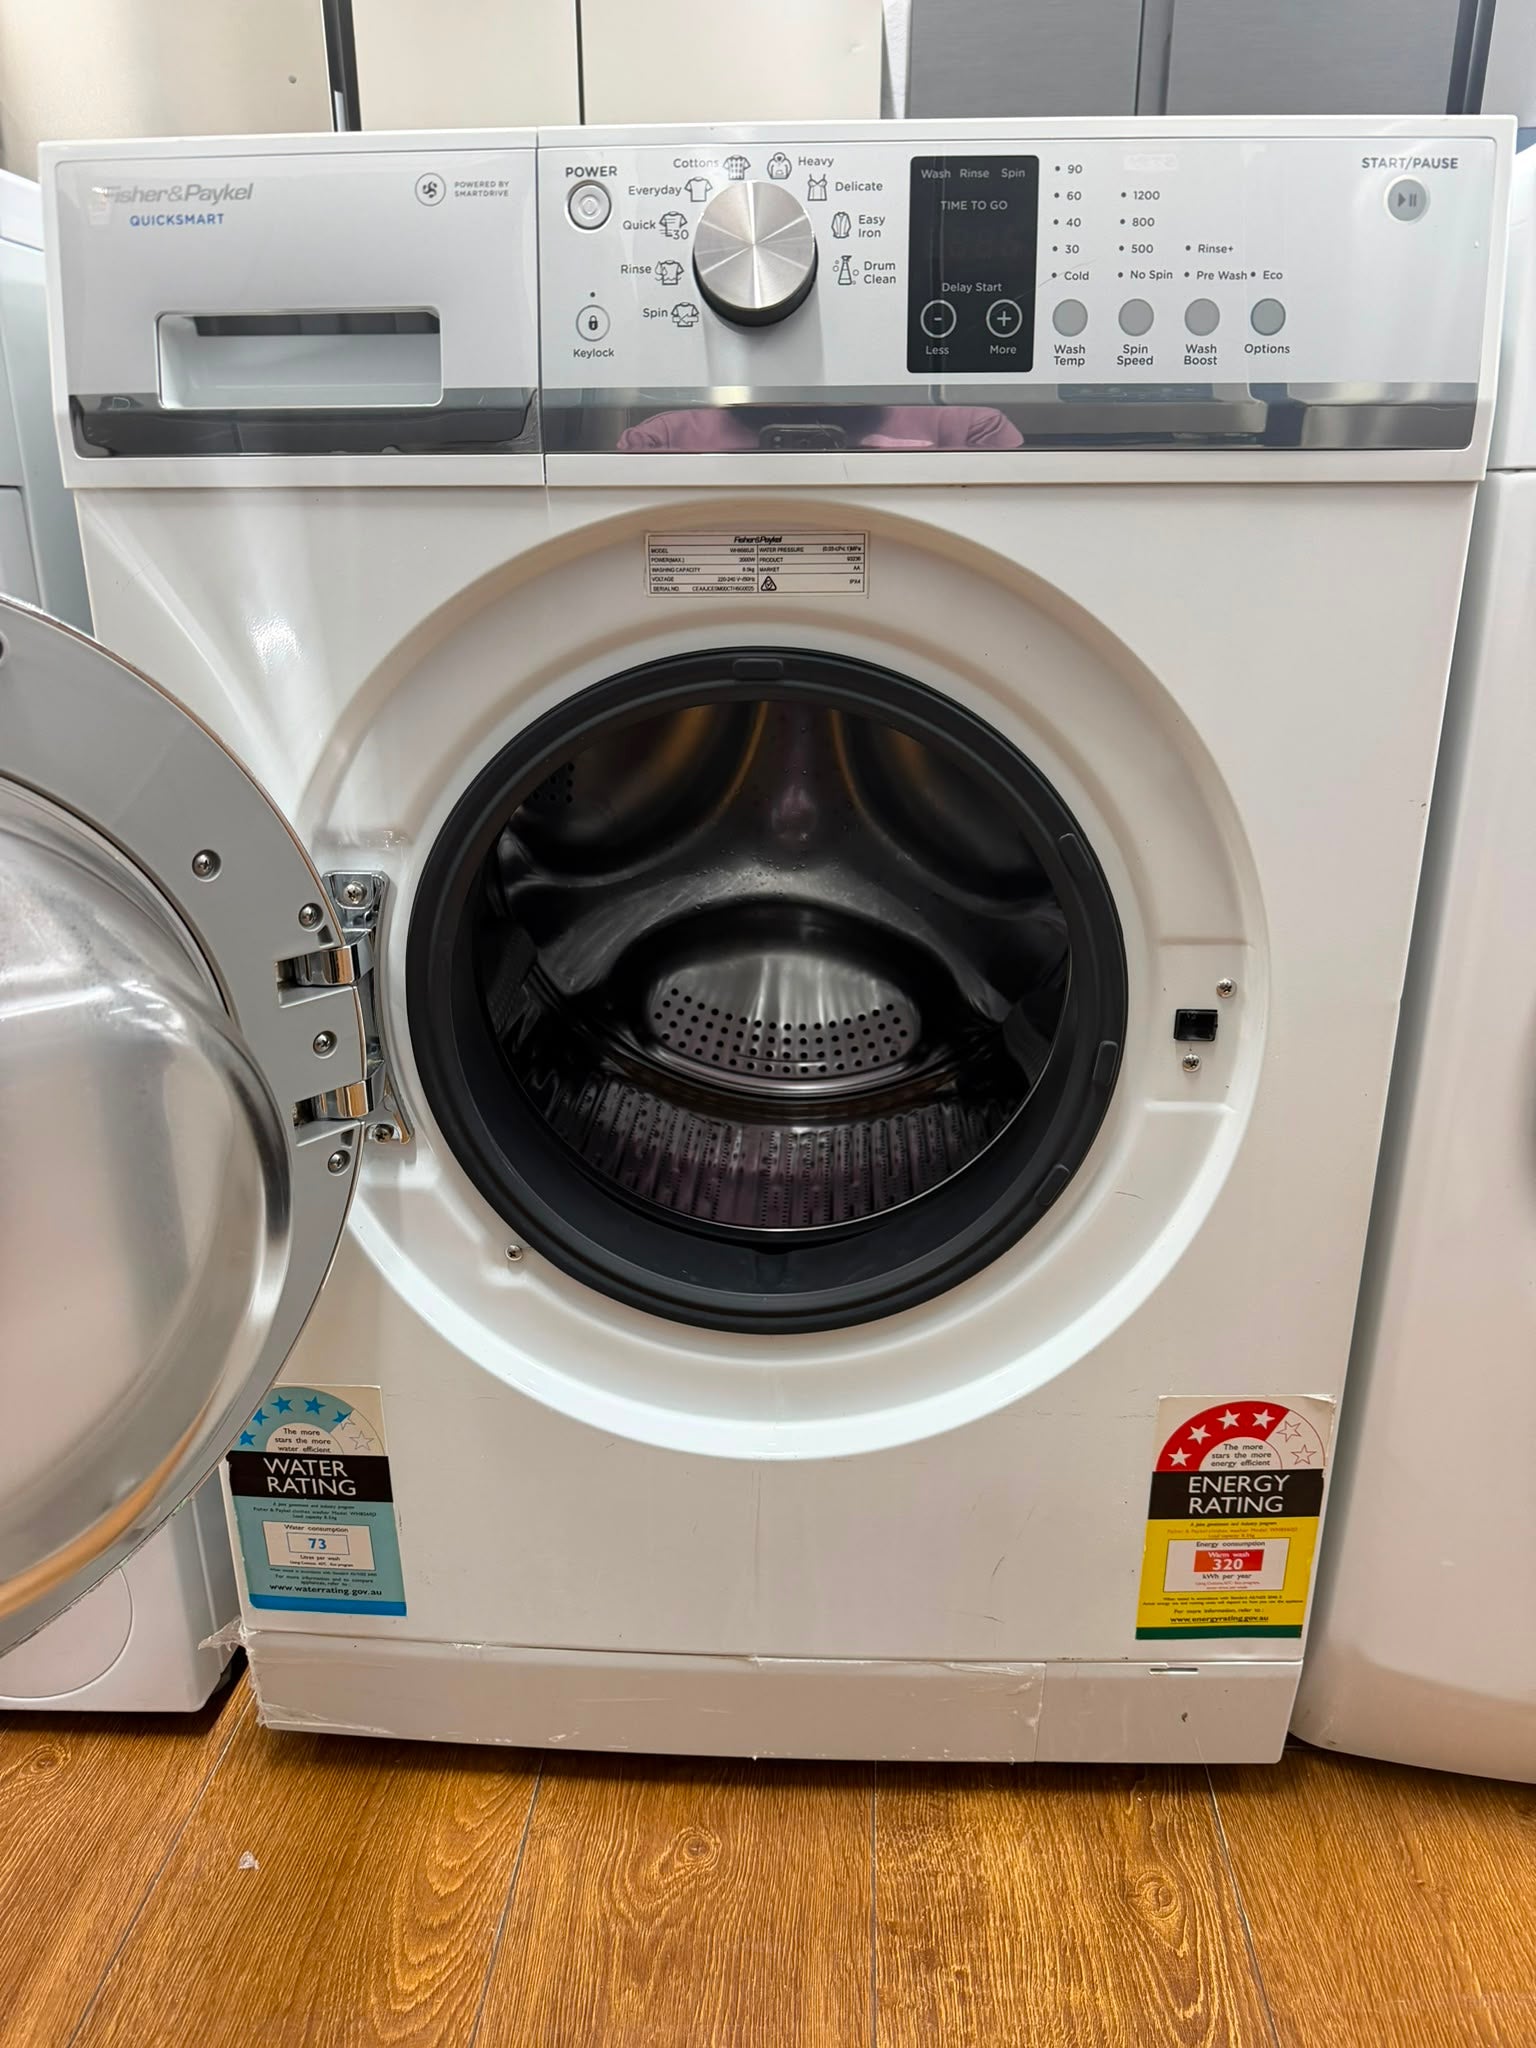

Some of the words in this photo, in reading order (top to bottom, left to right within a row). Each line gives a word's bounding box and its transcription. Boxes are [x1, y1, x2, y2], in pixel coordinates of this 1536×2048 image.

[673, 157, 720, 169] Cottons
[798, 156, 834, 168] Heavy
[1361, 157, 1459, 170] START/PAUSE
[565, 165, 618, 178] POWER
[921, 167, 952, 179] Wash
[960, 167, 990, 179] Rinse
[1001, 167, 1026, 180] Spin
[1067, 164, 1083, 175] 90
[498, 180, 509, 188] BY
[835, 181, 883, 192] Delicate
[628, 185, 682, 197] Everyday
[1067, 191, 1082, 201] 60
[1133, 190, 1160, 201] 1200
[941, 200, 968, 211] TIME
[970, 200, 988, 211] TO
[990, 200, 1008, 211] GO
[129, 213, 224, 227] QUICKSMART
[858, 215, 886, 228] Easy
[1066, 217, 1082, 228] 40
[1132, 217, 1155, 228] 800
[623, 220, 656, 232] Quick
[673, 230, 689, 240] 30
[858, 228, 881, 238] Iron
[1065, 244, 1080, 254] 30
[1131, 244, 1154, 254] 500
[1197, 243, 1234, 254] Rinse+
[620, 263, 652, 275] Rinse
[864, 261, 896, 271] Drum
[863, 273, 896, 284] Clean
[1064, 270, 1090, 281] Cold
[1130, 270, 1146, 281] No
[1149, 270, 1174, 282] Spin
[1196, 270, 1214, 281] Pre
[1217, 270, 1248, 281] Wash
[1263, 270, 1283, 281] Eco
[942, 282, 972, 294] Delay
[976, 281, 1003, 292] Start
[642, 307, 668, 319] Spin
[573, 348, 615, 360] Keylock
[925, 345, 949, 355] Less
[989, 345, 1017, 355] More
[1054, 344, 1086, 355] Wash
[1122, 344, 1149, 357] Spin
[1185, 344, 1217, 355] Wash
[1244, 343, 1290, 357] Options
[1054, 356, 1086, 368] Temp
[1116, 355, 1154, 368] Speed
[1184, 355, 1218, 366] Boost
[283, 1428, 297, 1436] The
[302, 1445, 331, 1453] efficient
[1234, 1451, 1248, 1459] the
[263, 1457, 348, 1477] WATER
[1211, 1460, 1237, 1468] energy
[1240, 1458, 1271, 1467] efficient
[267, 1476, 357, 1496] RATING
[1188, 1474, 1290, 1494] ENERGY
[1189, 1495, 1284, 1515] RATING
[284, 1523, 304, 1531] Water
[307, 1525, 349, 1533] consumption
[308, 1538, 327, 1550] 73
[1196, 1541, 1219, 1549] Energy
[1222, 1540, 1266, 1548] consumption
[1212, 1558, 1243, 1570] 320
[269, 1584, 383, 1597] www.waterrating.gov.au
